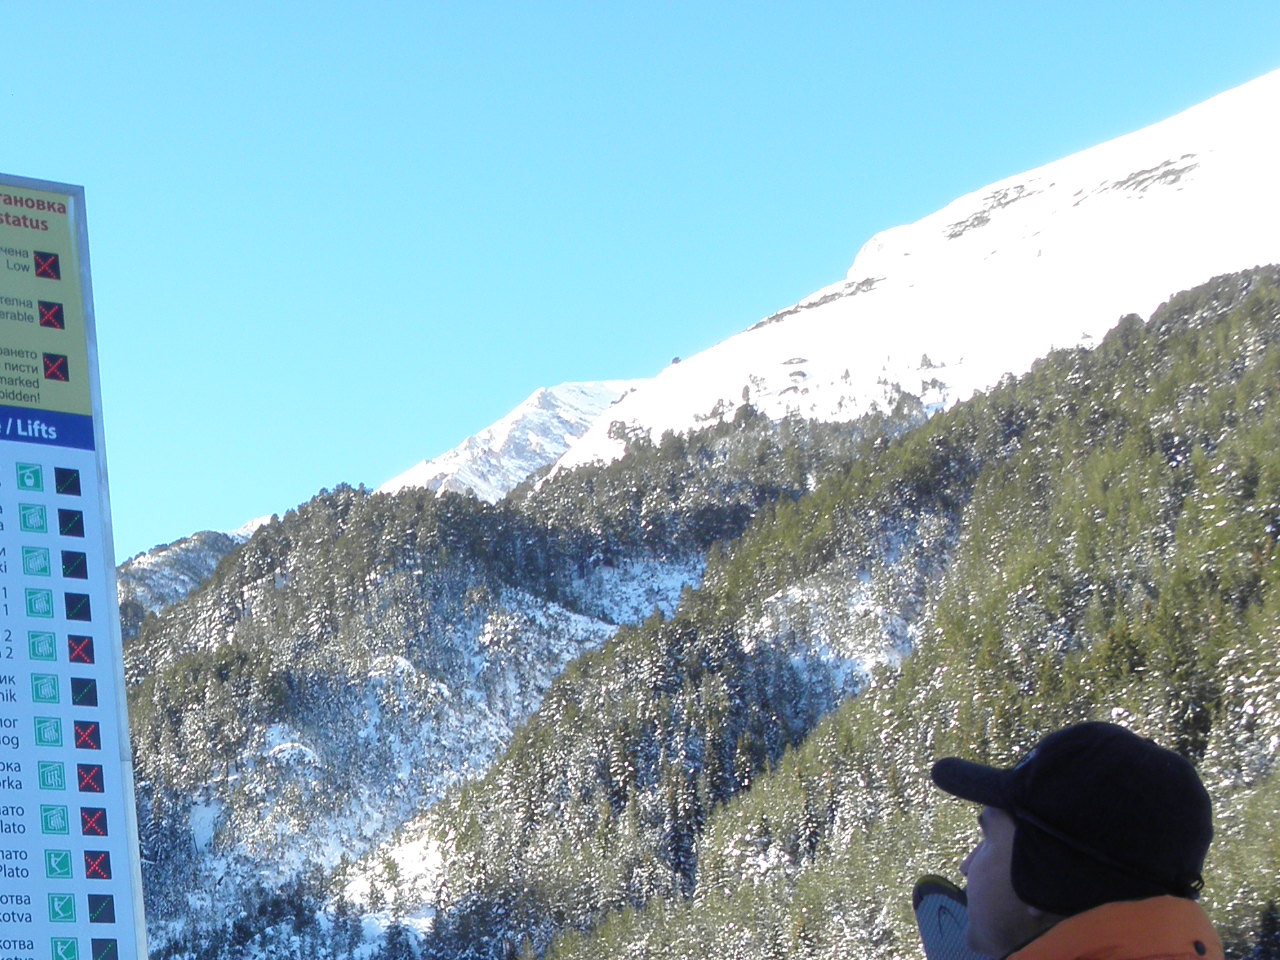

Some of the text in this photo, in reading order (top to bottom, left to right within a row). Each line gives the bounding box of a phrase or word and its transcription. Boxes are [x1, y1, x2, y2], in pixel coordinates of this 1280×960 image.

[6, 260, 30, 272] Low
[17, 419, 57, 440] Lifts
[2, 587, 8, 598] 1
[4, 604, 9, 616] 1
